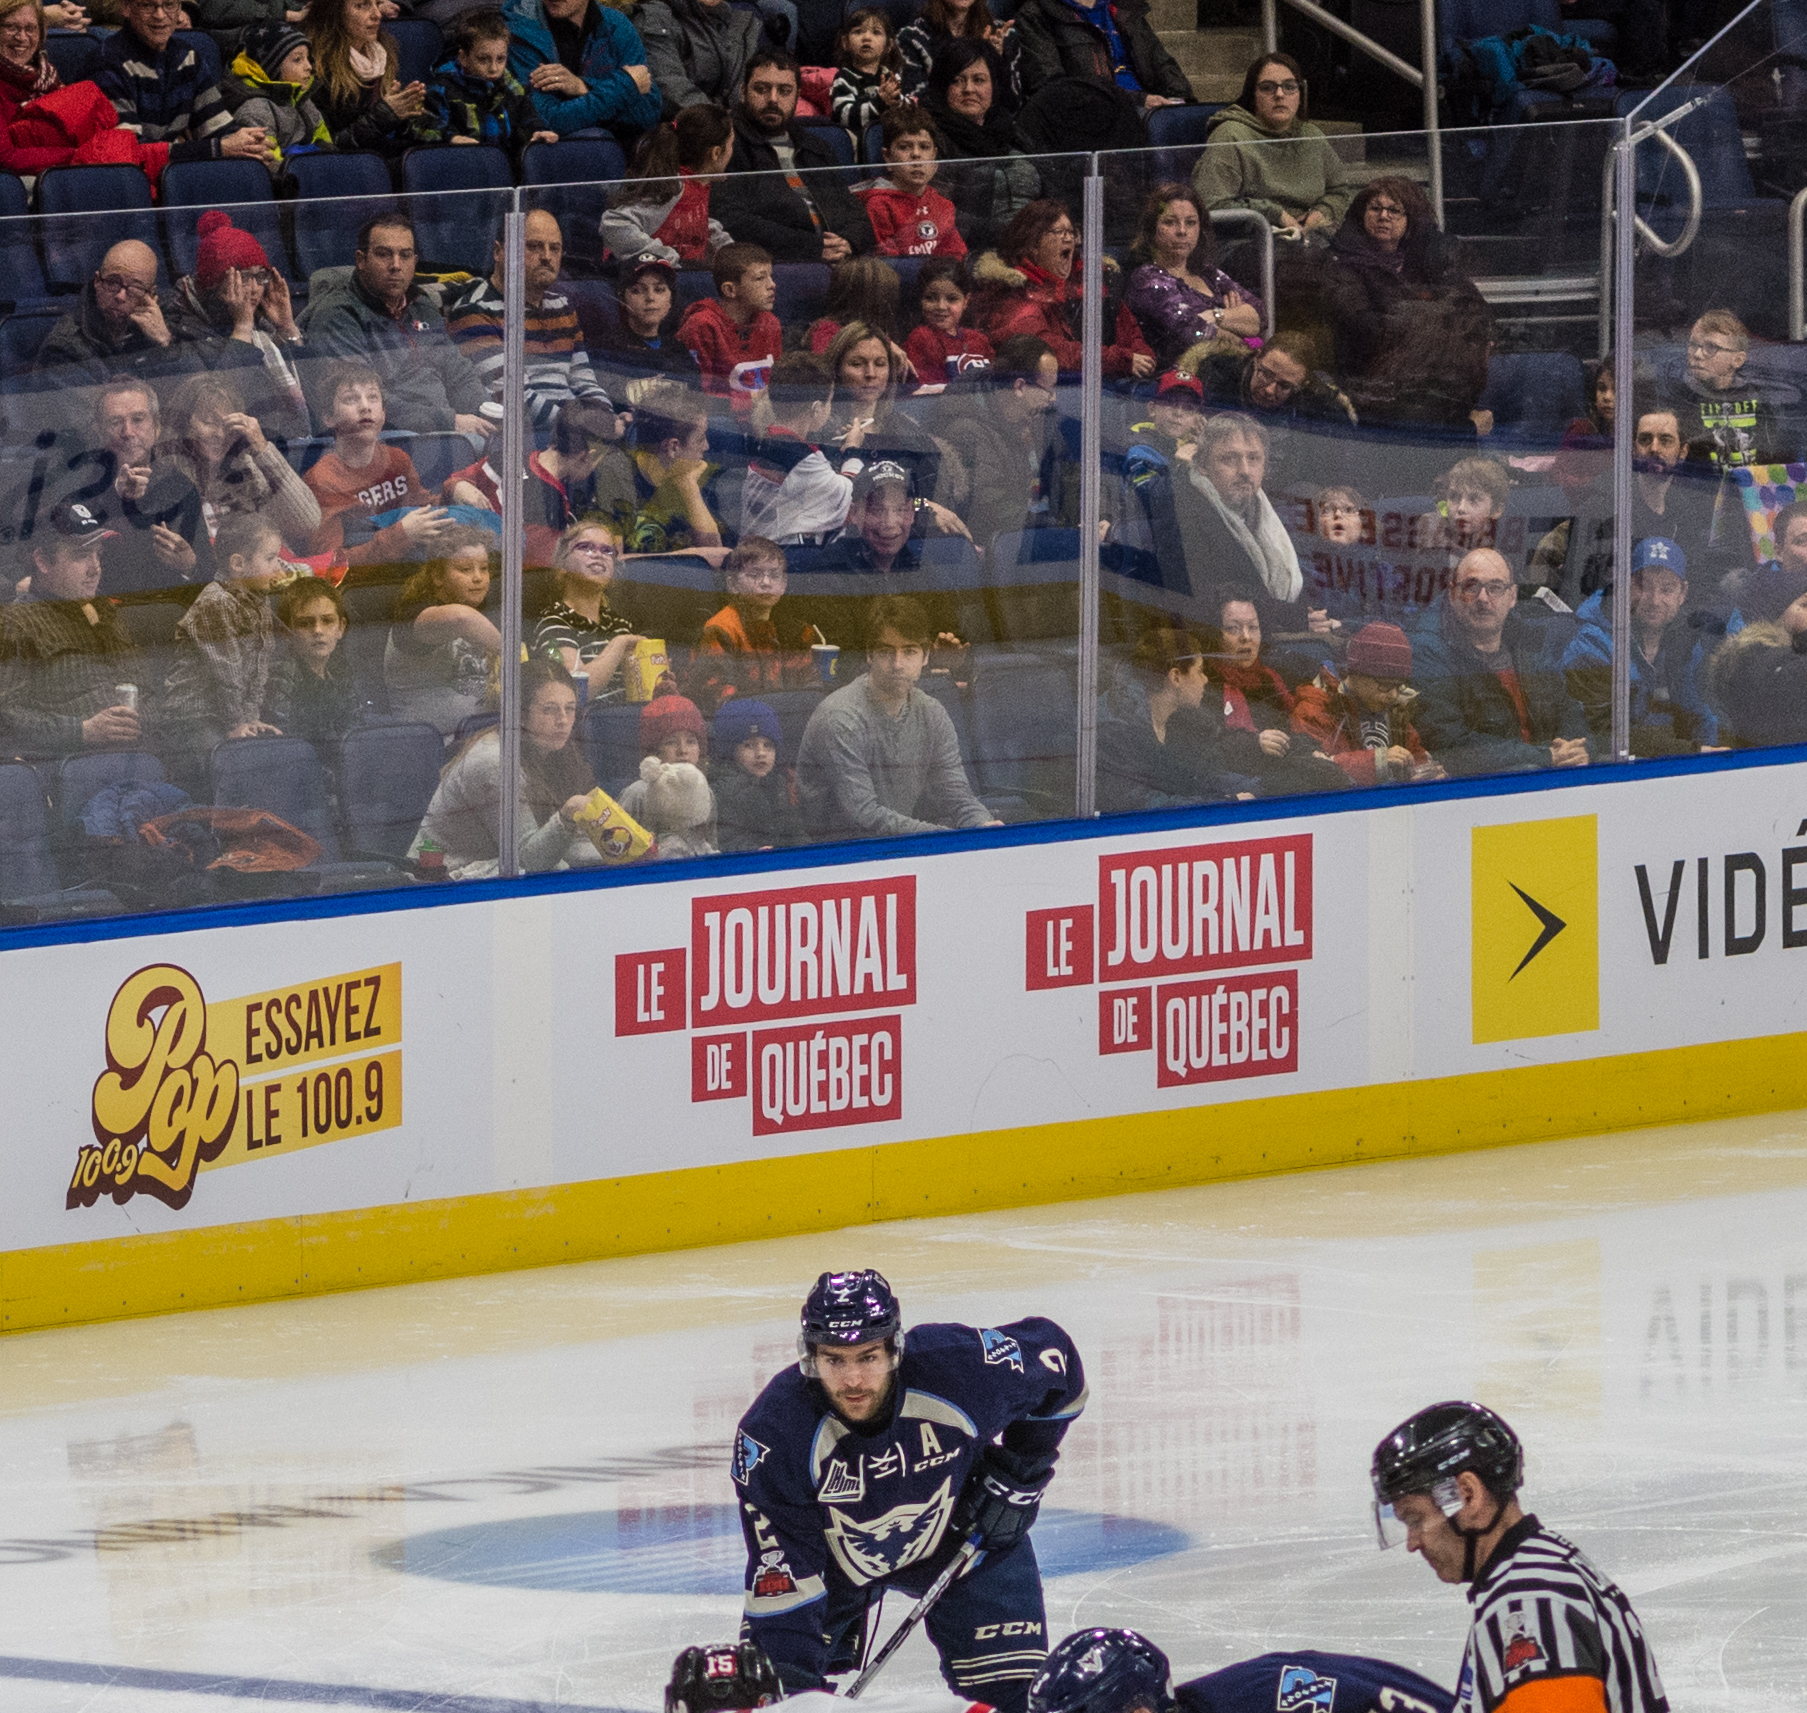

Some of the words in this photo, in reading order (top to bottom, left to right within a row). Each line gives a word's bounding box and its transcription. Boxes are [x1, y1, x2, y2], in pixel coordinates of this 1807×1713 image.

[1108, 853, 1305, 968] JOURNAL
[700, 894, 908, 1012] JOURNAL
[1046, 918, 1073, 979] LE
[245, 975, 383, 1065] ESSAYEZ
[636, 962, 665, 1023] LE
[1112, 995, 1139, 1045] DE
[1164, 985, 1291, 1080] QUÉBEC
[245, 1083, 284, 1151] LE
[297, 1060, 384, 1132] 100.9
[706, 1044, 733, 1093] DE
[760, 1030, 894, 1127] QUÉBEC
[71, 1143, 147, 1194] 100.9
[828, 1318, 864, 1330] CCM
[913, 1447, 961, 1473] CCM
[919, 1423, 942, 1458] A
[974, 1622, 1043, 1641] CCM
[706, 1655, 735, 1677] 15
